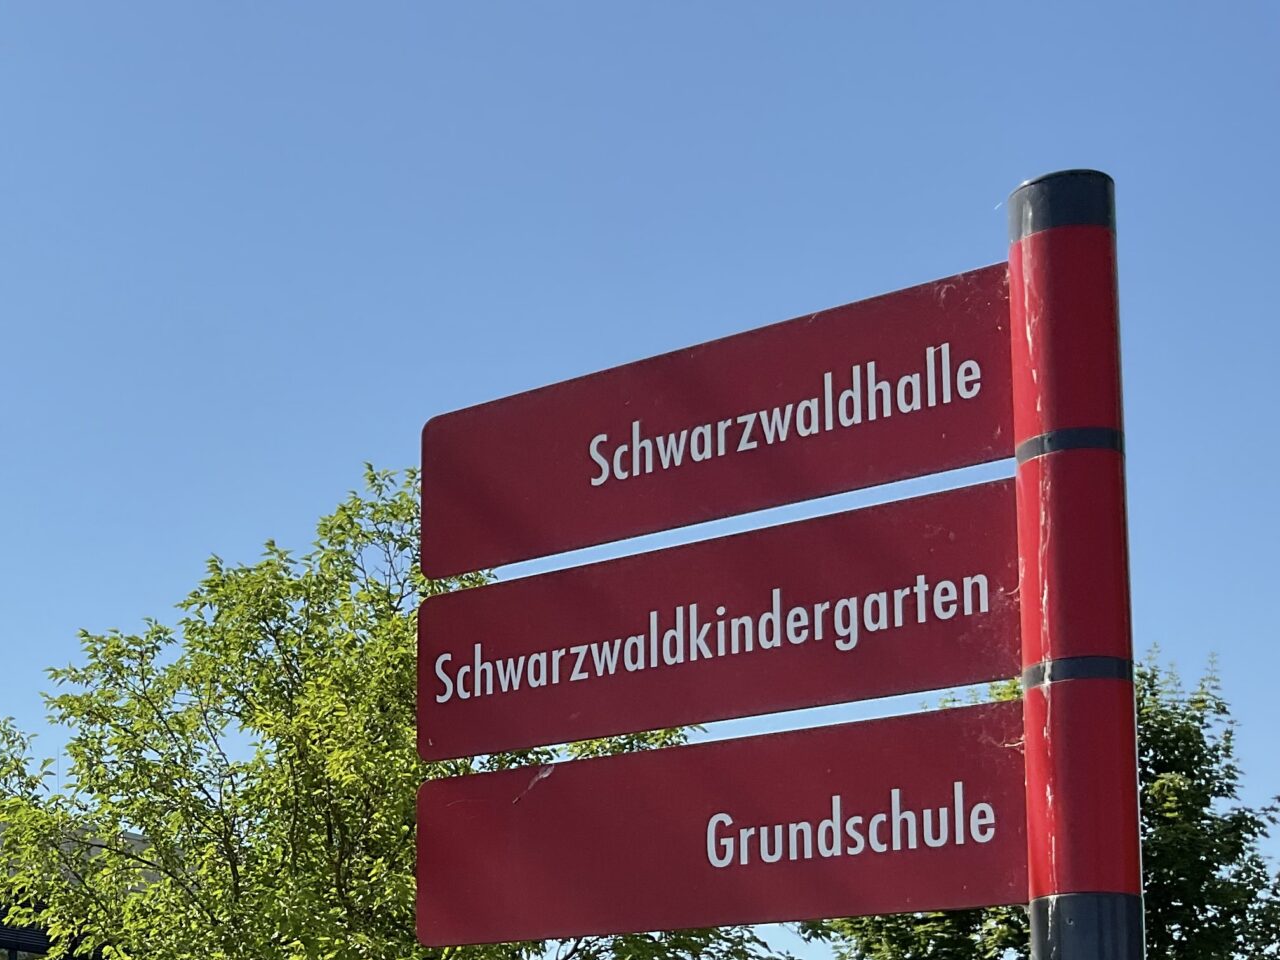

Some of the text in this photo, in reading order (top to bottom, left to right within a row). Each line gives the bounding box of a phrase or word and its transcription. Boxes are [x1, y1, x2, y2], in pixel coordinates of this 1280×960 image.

[589, 342, 982, 486] Schwarzwaldhalle
[435, 573, 989, 703] Schwarzwaldkindergarten
[707, 781, 996, 868] Grundschule
